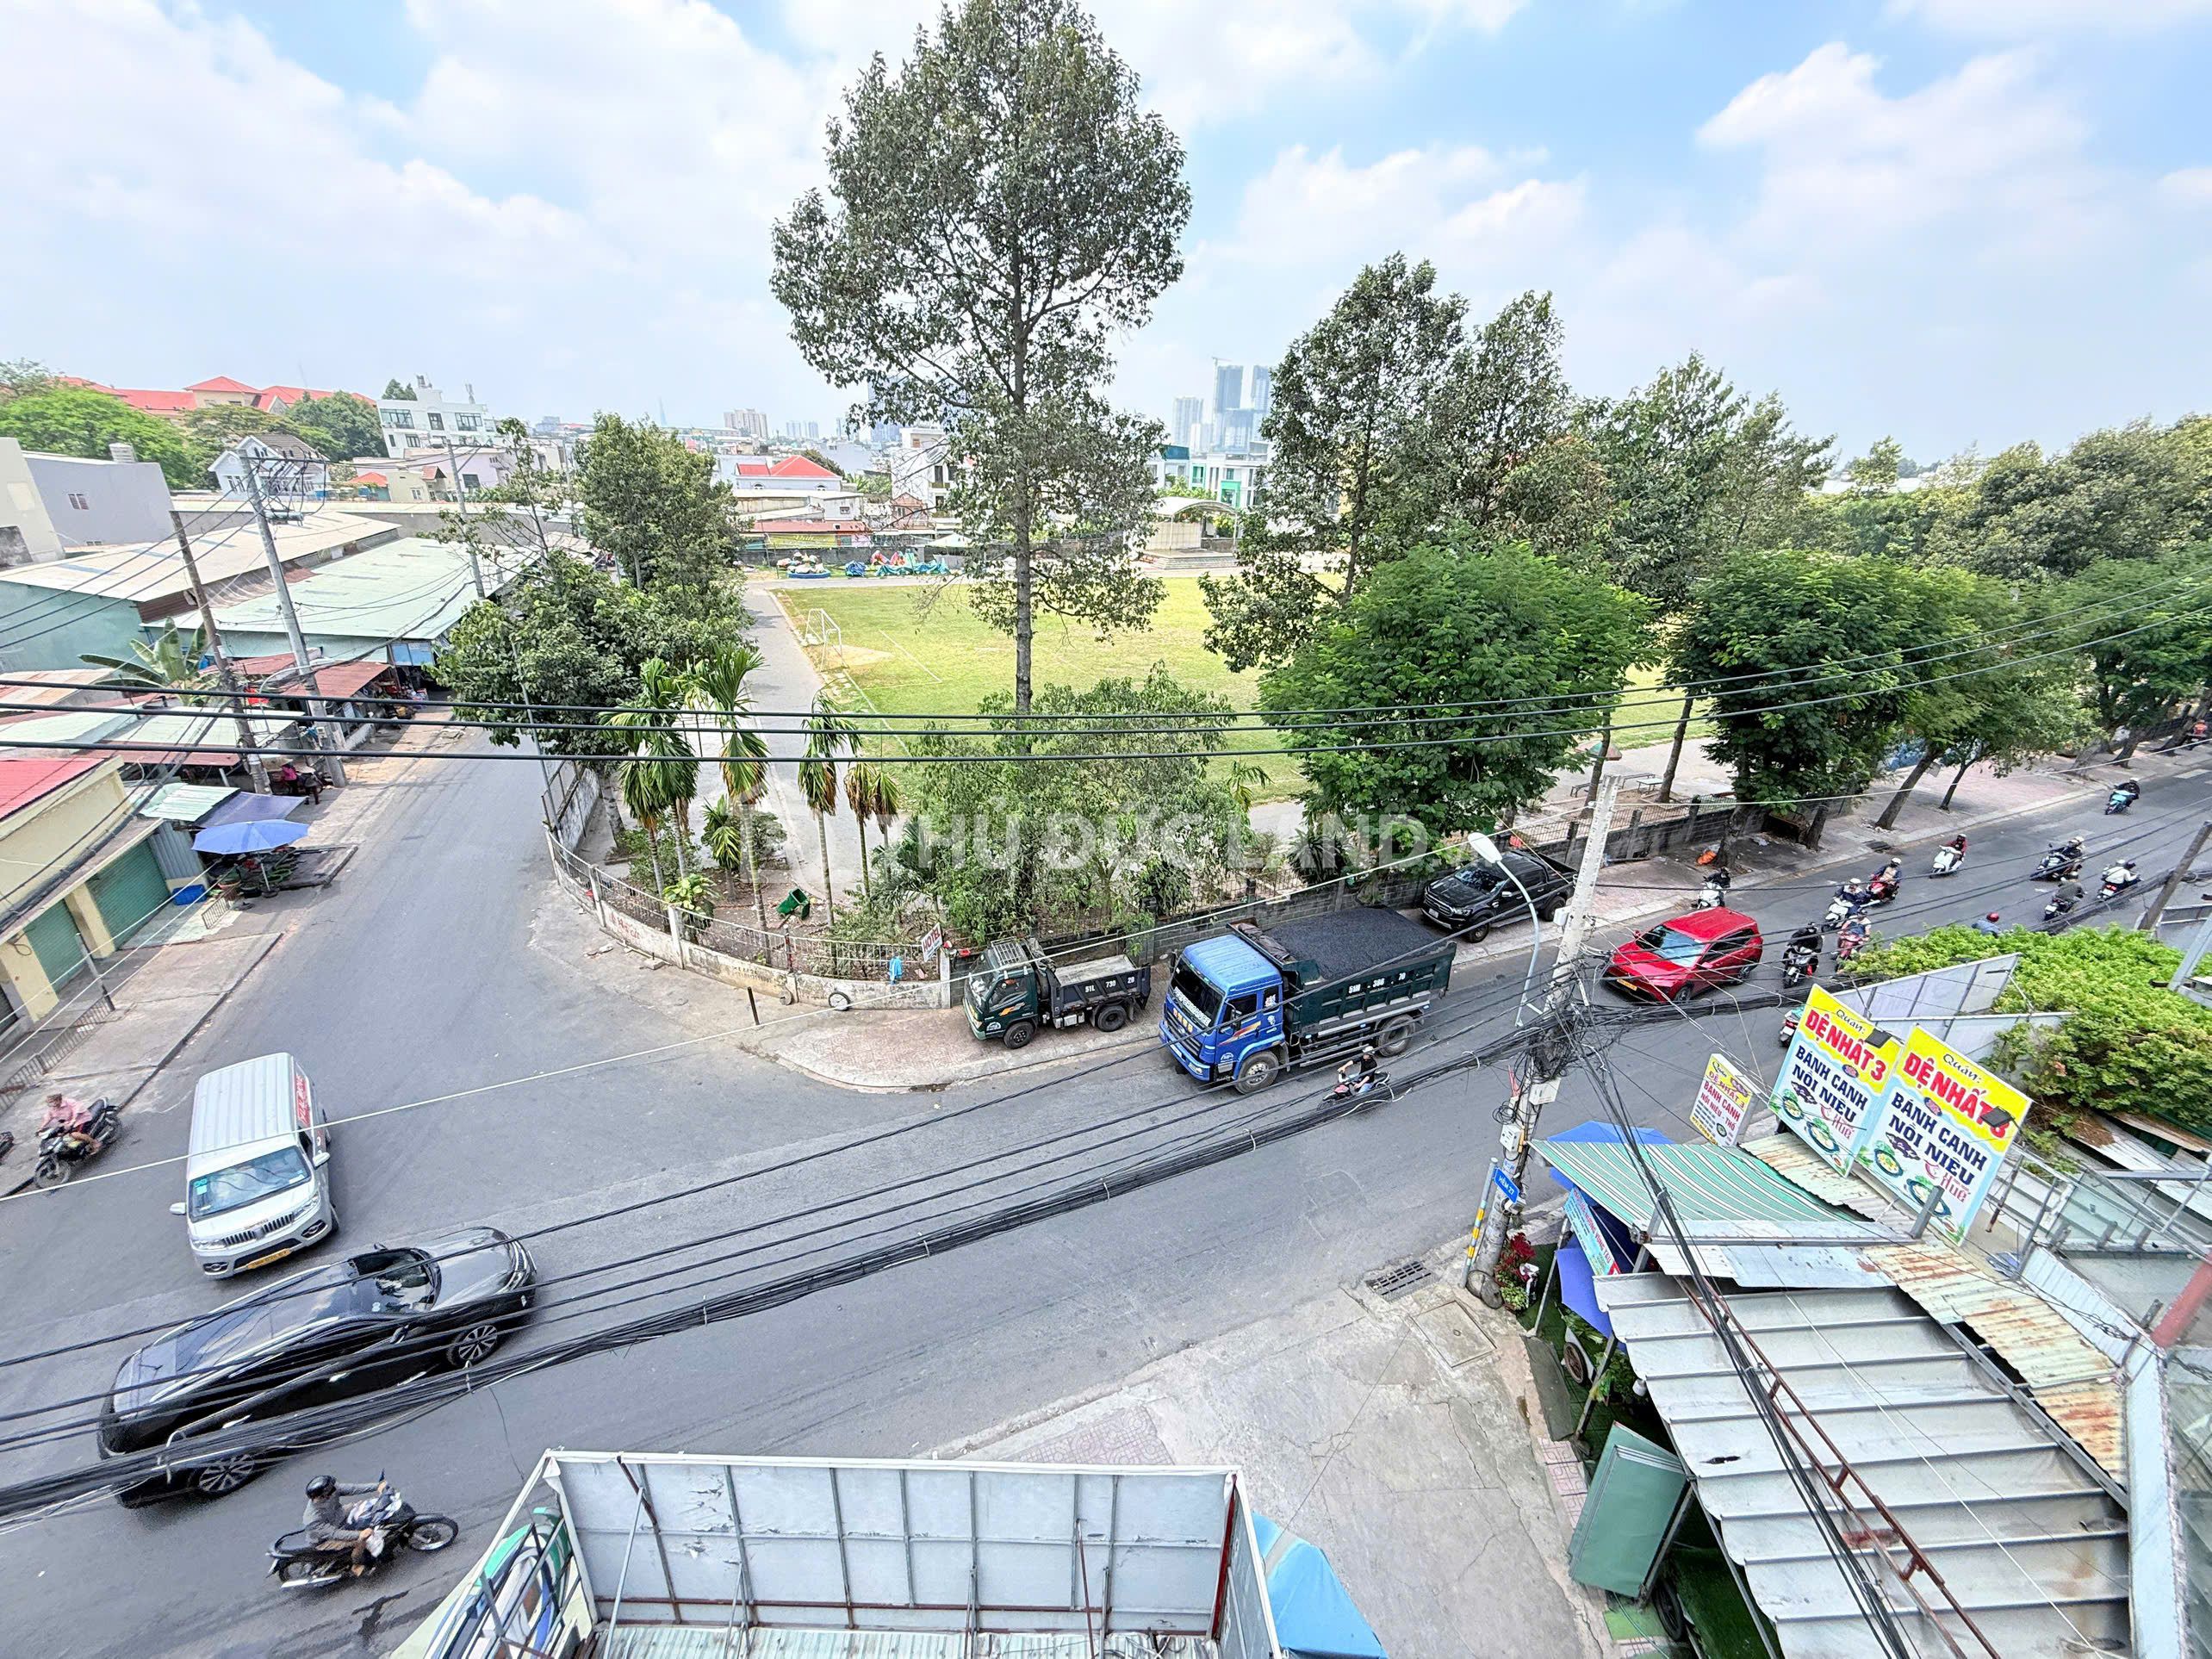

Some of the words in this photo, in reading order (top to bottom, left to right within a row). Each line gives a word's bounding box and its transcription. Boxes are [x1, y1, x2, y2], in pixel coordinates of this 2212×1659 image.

[1795, 1045, 1831, 1082] BÁNH
[1831, 1074, 1868, 1111] CANH
[1870, 1059, 1886, 1082] 3
[1903, 1052, 1935, 1090] ĐỆ
[1721, 1098, 1742, 1122] CANH
[1818, 1086, 1857, 1123] NIÊU
[1891, 1091, 1937, 1134] BÁNH
[1938, 1127, 1987, 1171] CANH
[1924, 1141, 1975, 1186] NIÊU
[1940, 1172, 1971, 1202] Huế
